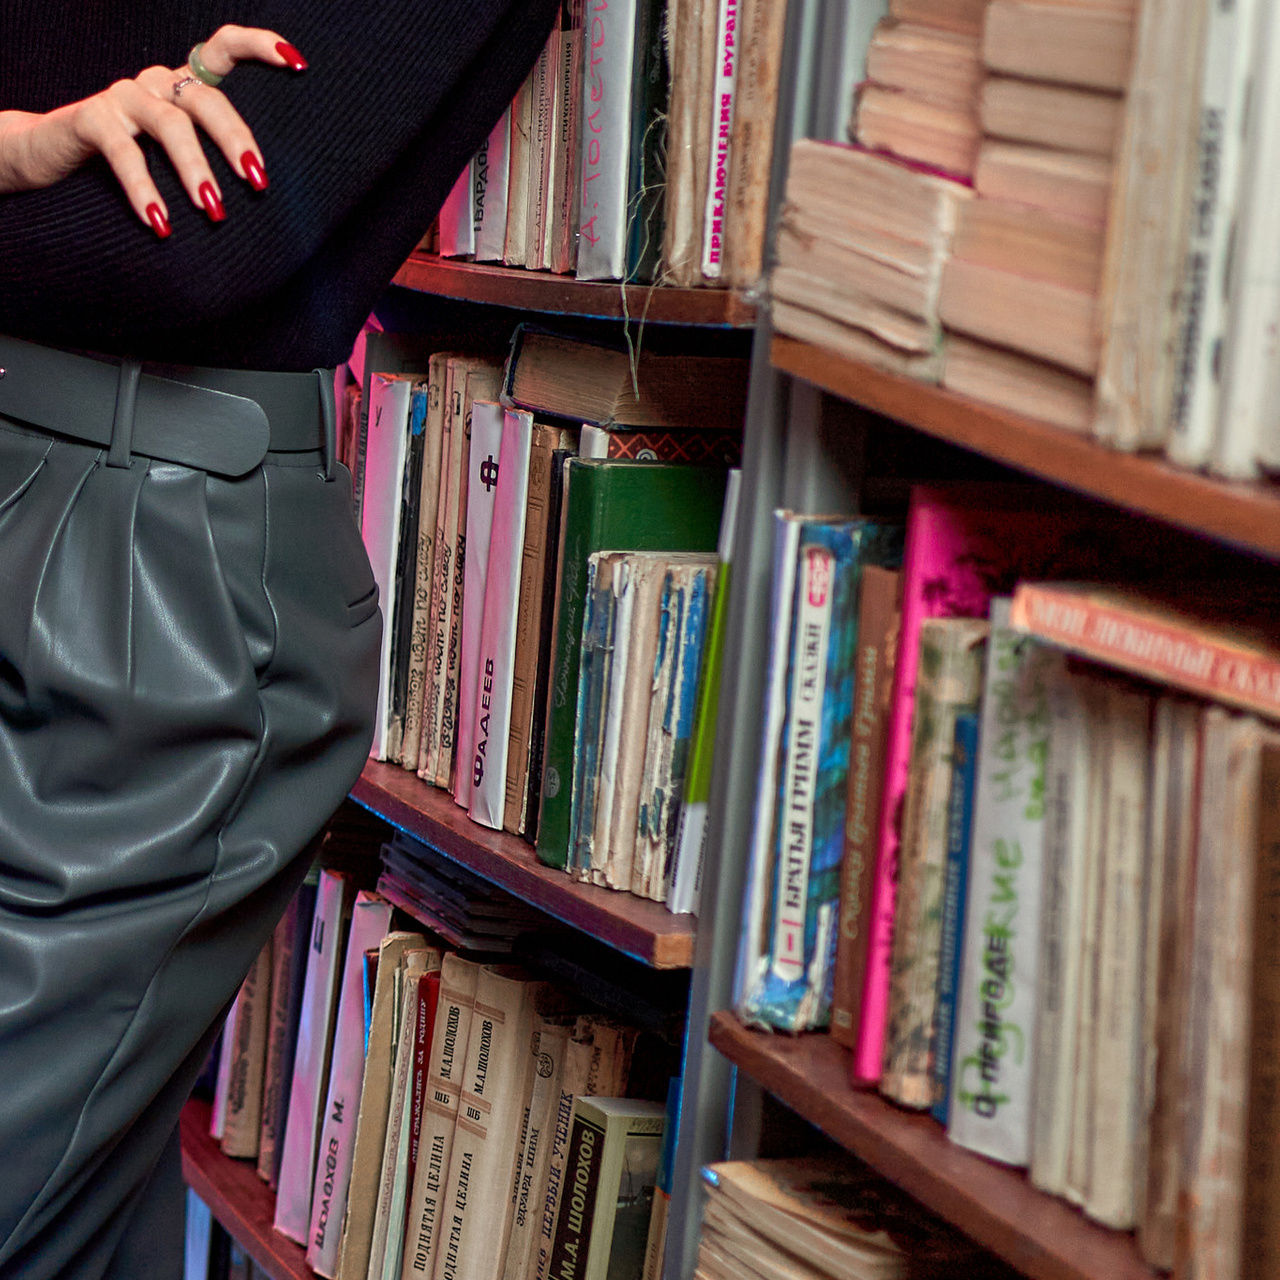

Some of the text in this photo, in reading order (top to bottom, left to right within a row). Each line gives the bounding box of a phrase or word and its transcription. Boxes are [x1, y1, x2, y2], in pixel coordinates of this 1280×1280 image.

[561, 42, 572, 142] СТИХОТВОРЕНИЯ
[709, 92, 732, 264] ПРИКЛЮЧЕНИЯ
[799, 623, 822, 702] СКАЗКИ
[473, 657, 494, 788] ФАДЕЕВ
[790, 720, 815, 813] ГРИММ
[782, 821, 807, 910] БРАТЬЯ
[417, 1050, 425, 1065] ЗА
[418, 998, 427, 1044] РОДИНУ
[439, 1005, 461, 1079] М.А.ШОЛОХОВ
[472, 1020, 494, 1095] М.А.ШОЛОХОВ
[413, 1069, 423, 1135] СРАЖАЛИСЬ
[315, 1097, 345, 1250] ШОЛОХОВ М.
[412, 1135, 446, 1271] ПОДНЯТАЯ ЦЕЛИНА
[453, 1152, 475, 1211] ЦЕЛИНА
[516, 1127, 540, 1227] ЭДУАРД ШИМ
[540, 1166, 562, 1239] ПЕРВЫЙ
[552, 1089, 574, 1157] УЧЕНИК
[567, 1129, 596, 1234] ШОЛОХОВ
